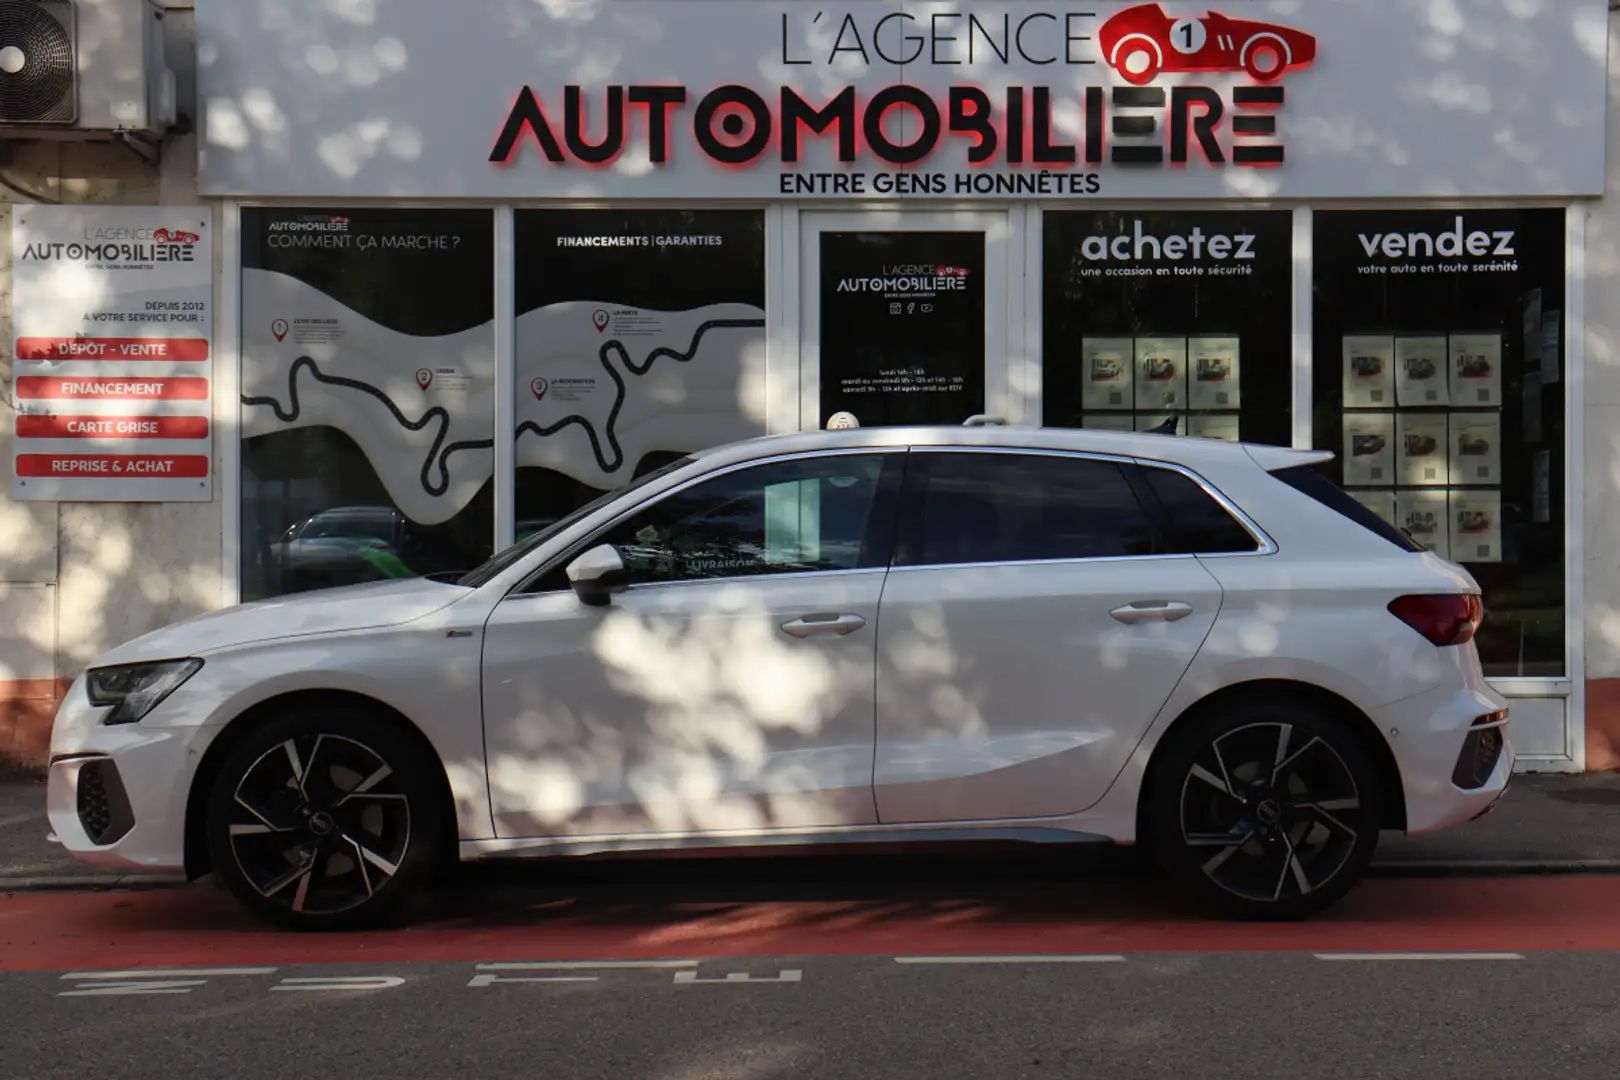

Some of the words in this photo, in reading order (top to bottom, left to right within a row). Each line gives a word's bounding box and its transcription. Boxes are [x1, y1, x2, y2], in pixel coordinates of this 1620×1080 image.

[781, 13, 1096, 65] L'AGENCE
[780, 173, 865, 194] ENTRE
[873, 173, 946, 194] GENS
[955, 170, 1100, 194] HONNÊTES
[84, 227, 154, 240] L'AGENCE
[1081, 219, 1256, 260] achetez
[1357, 216, 1515, 257] vendez
[267, 234, 352, 248] COMMENT
[357, 236, 378, 250] ÇA
[382, 235, 447, 249] MARCHE
[556, 236, 649, 247] FINANCEMENTS
[655, 235, 722, 246] GARANTIES
[882, 265, 936, 275] L'AGENCE
[1081, 269, 1102, 277] une
[1105, 265, 1152, 276] occasion
[1156, 267, 1170, 275] en
[1174, 265, 1204, 275] toute
[1208, 264, 1252, 275] sécurité
[1357, 263, 1387, 274] votre
[1391, 264, 1417, 273] auto
[1438, 262, 1468, 272] toute
[146, 302, 179, 310] DEPUIS
[183, 302, 205, 310] 2012
[92, 313, 125, 322] VOTRE
[128, 313, 167, 322] SERVICE
[170, 313, 197, 322] POUR
[120, 344, 166, 355] VENTE
[61, 383, 163, 395] FINANCEMENT
[67, 421, 113, 433] CARTE
[117, 421, 158, 433] GRISE
[52, 460, 109, 472] REPRISE
[112, 461, 120, 472] &
[126, 460, 173, 473] ACHAT
